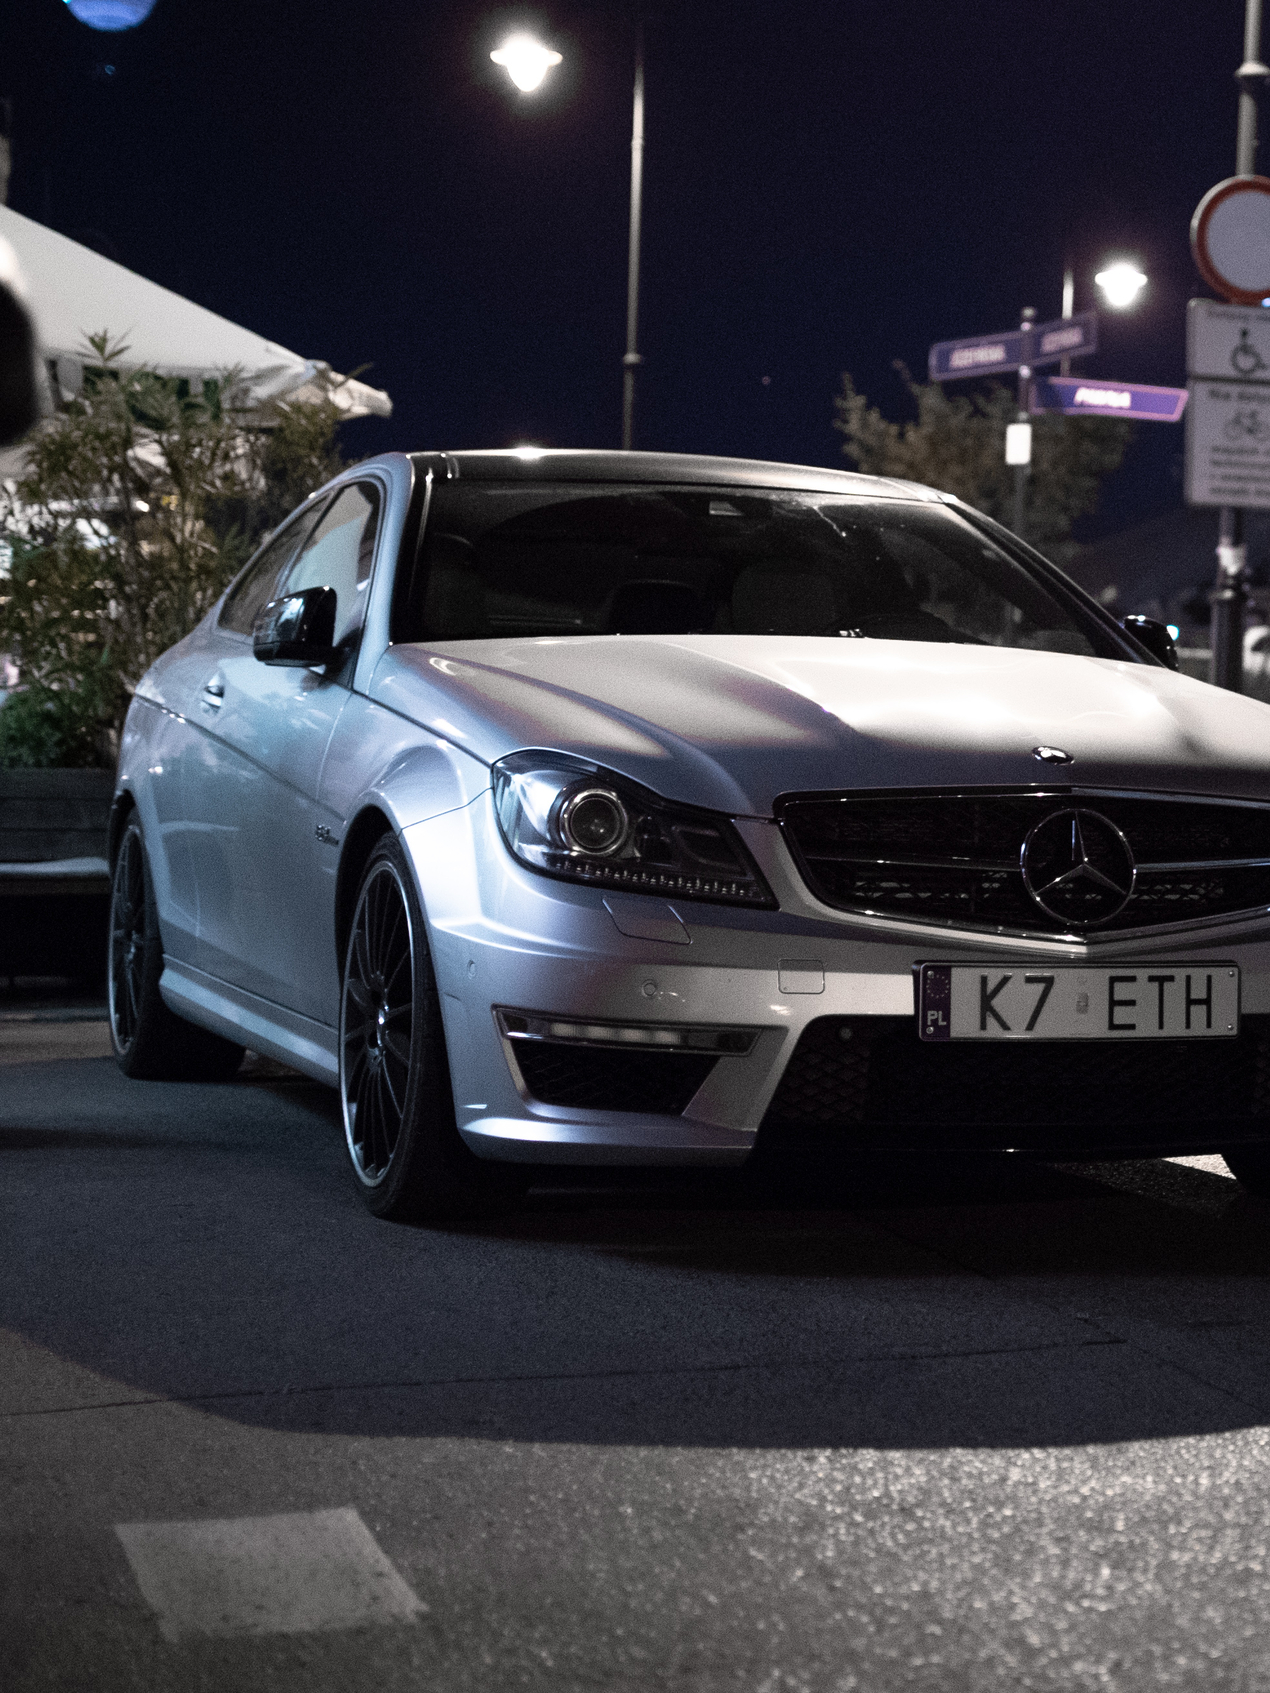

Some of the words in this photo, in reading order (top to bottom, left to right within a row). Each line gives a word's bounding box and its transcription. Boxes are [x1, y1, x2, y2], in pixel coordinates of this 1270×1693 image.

[927, 1010, 947, 1027] PL
[979, 973, 1055, 1031] K7
[1108, 974, 1213, 1031] ETH
